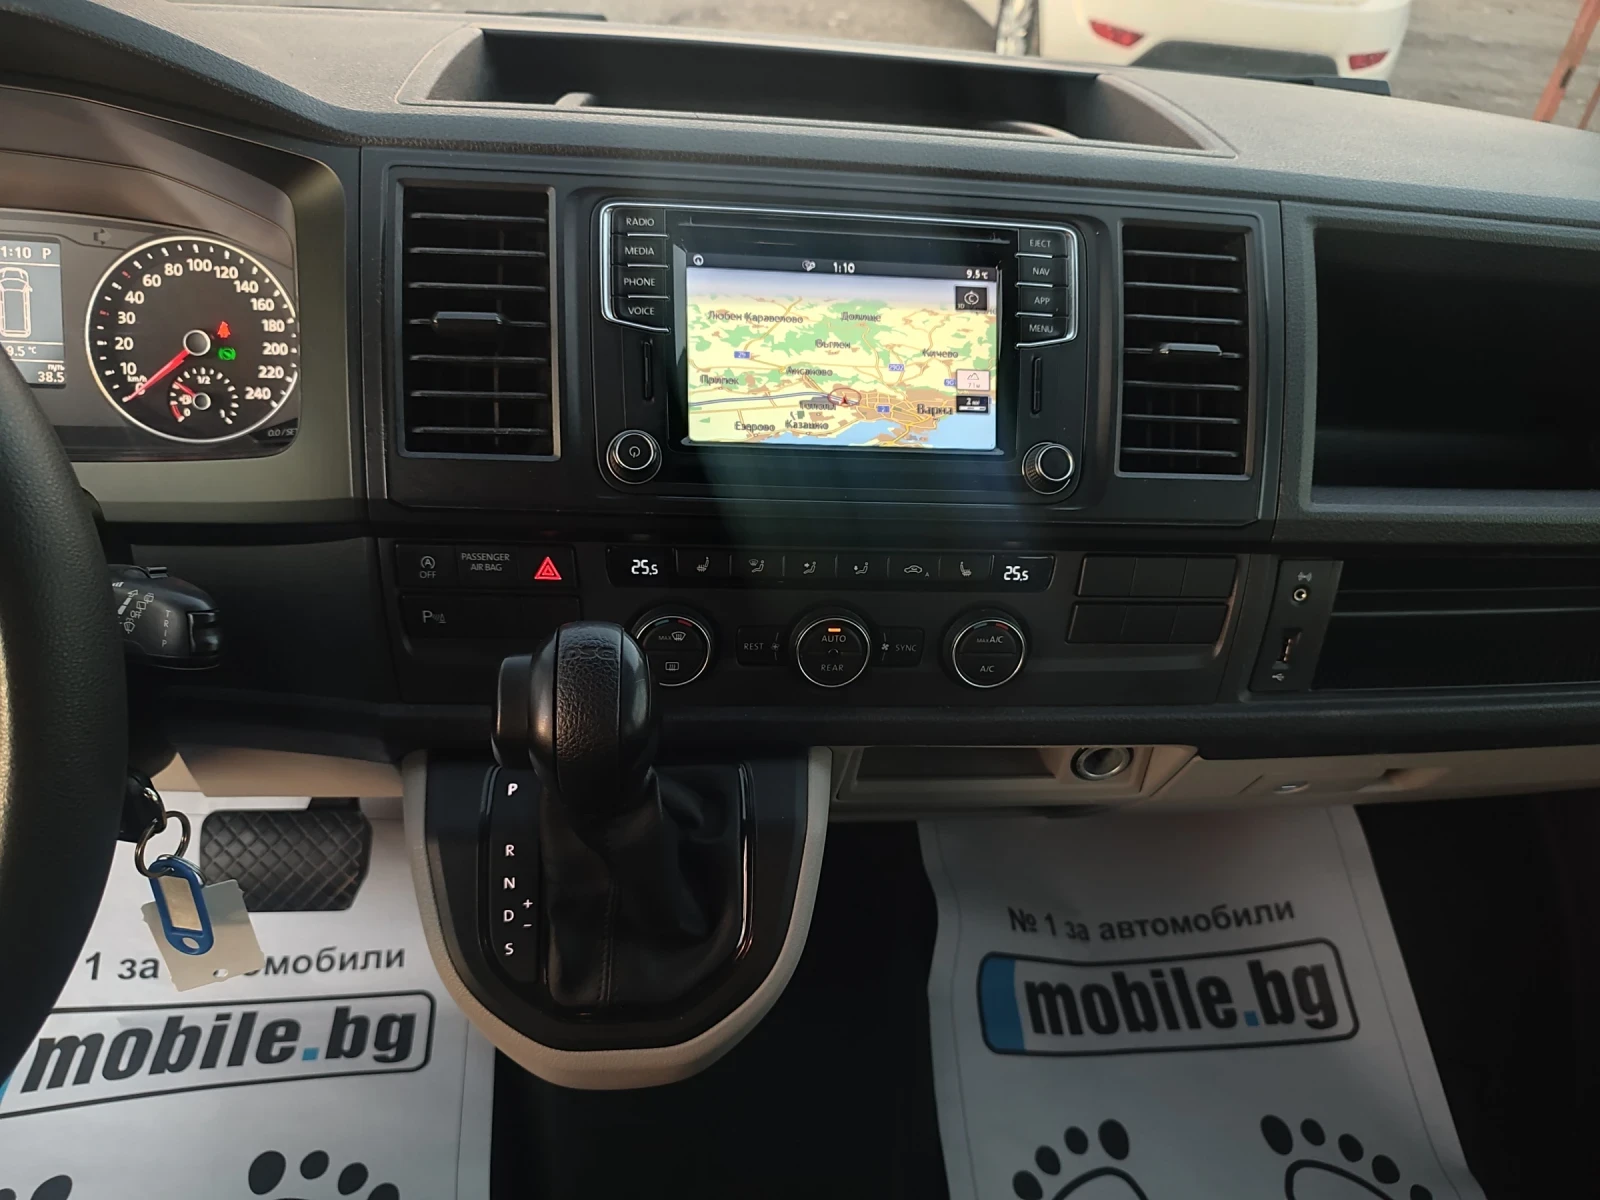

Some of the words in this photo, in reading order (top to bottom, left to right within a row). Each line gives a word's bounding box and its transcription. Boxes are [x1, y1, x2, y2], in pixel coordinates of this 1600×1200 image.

[626, 217, 655, 227] RADIO
[1029, 239, 1052, 248] EJECT
[42, 247, 52, 259] P
[624, 246, 655, 256] MEDIA
[164, 263, 184, 277] 80
[186, 258, 213, 273] 100
[833, 261, 856, 273] 1:10
[1032, 267, 1051, 276] NAV
[213, 265, 239, 280] 120
[143, 274, 162, 288] 60
[234, 280, 259, 294] 140
[623, 277, 656, 287] PHONE
[124, 290, 145, 305] 40
[1034, 297, 1050, 305] APP
[250, 298, 275, 312] 160
[628, 307, 655, 316] VOICE
[117, 311, 136, 325] 30
[262, 319, 285, 333] 180
[1029, 324, 1054, 333] MENU
[114, 337, 134, 351] 20
[262, 342, 289, 356] 200
[120, 362, 137, 376] 10
[258, 365, 284, 380] 220
[37, 371, 65, 383] 38.5
[127, 374, 148, 383] km/h
[196, 375, 211, 385] 1/2
[245, 386, 271, 401] 240
[917, 403, 954, 416] Варна
[461, 552, 510, 562] PASSENGER
[470, 563, 484, 572] AIR
[484, 563, 503, 572] BAG
[630, 559, 659, 576] 25.5
[1003, 565, 1030, 582] 25.5
[419, 570, 437, 579] OFF
[129, 609, 142, 619] OFF
[161, 609, 172, 648] TRIP
[821, 634, 847, 643] AUTO
[743, 642, 764, 650] REST
[895, 643, 917, 652] SYNC
[820, 664, 844, 672] REAR
[979, 665, 995, 673] A/C
[507, 782, 519, 796] P
[505, 844, 515, 857] R
[503, 877, 516, 889] N
[503, 909, 515, 922] D
[1044, 912, 1057, 937] 1
[1065, 920, 1091, 942] за
[1099, 900, 1296, 942] автомобили
[505, 942, 514, 956] S
[84, 951, 102, 981] 1
[116, 956, 161, 981] за
[1024, 958, 1340, 1038] mobile.bg
[20, 1005, 418, 1094] mobile.bg
